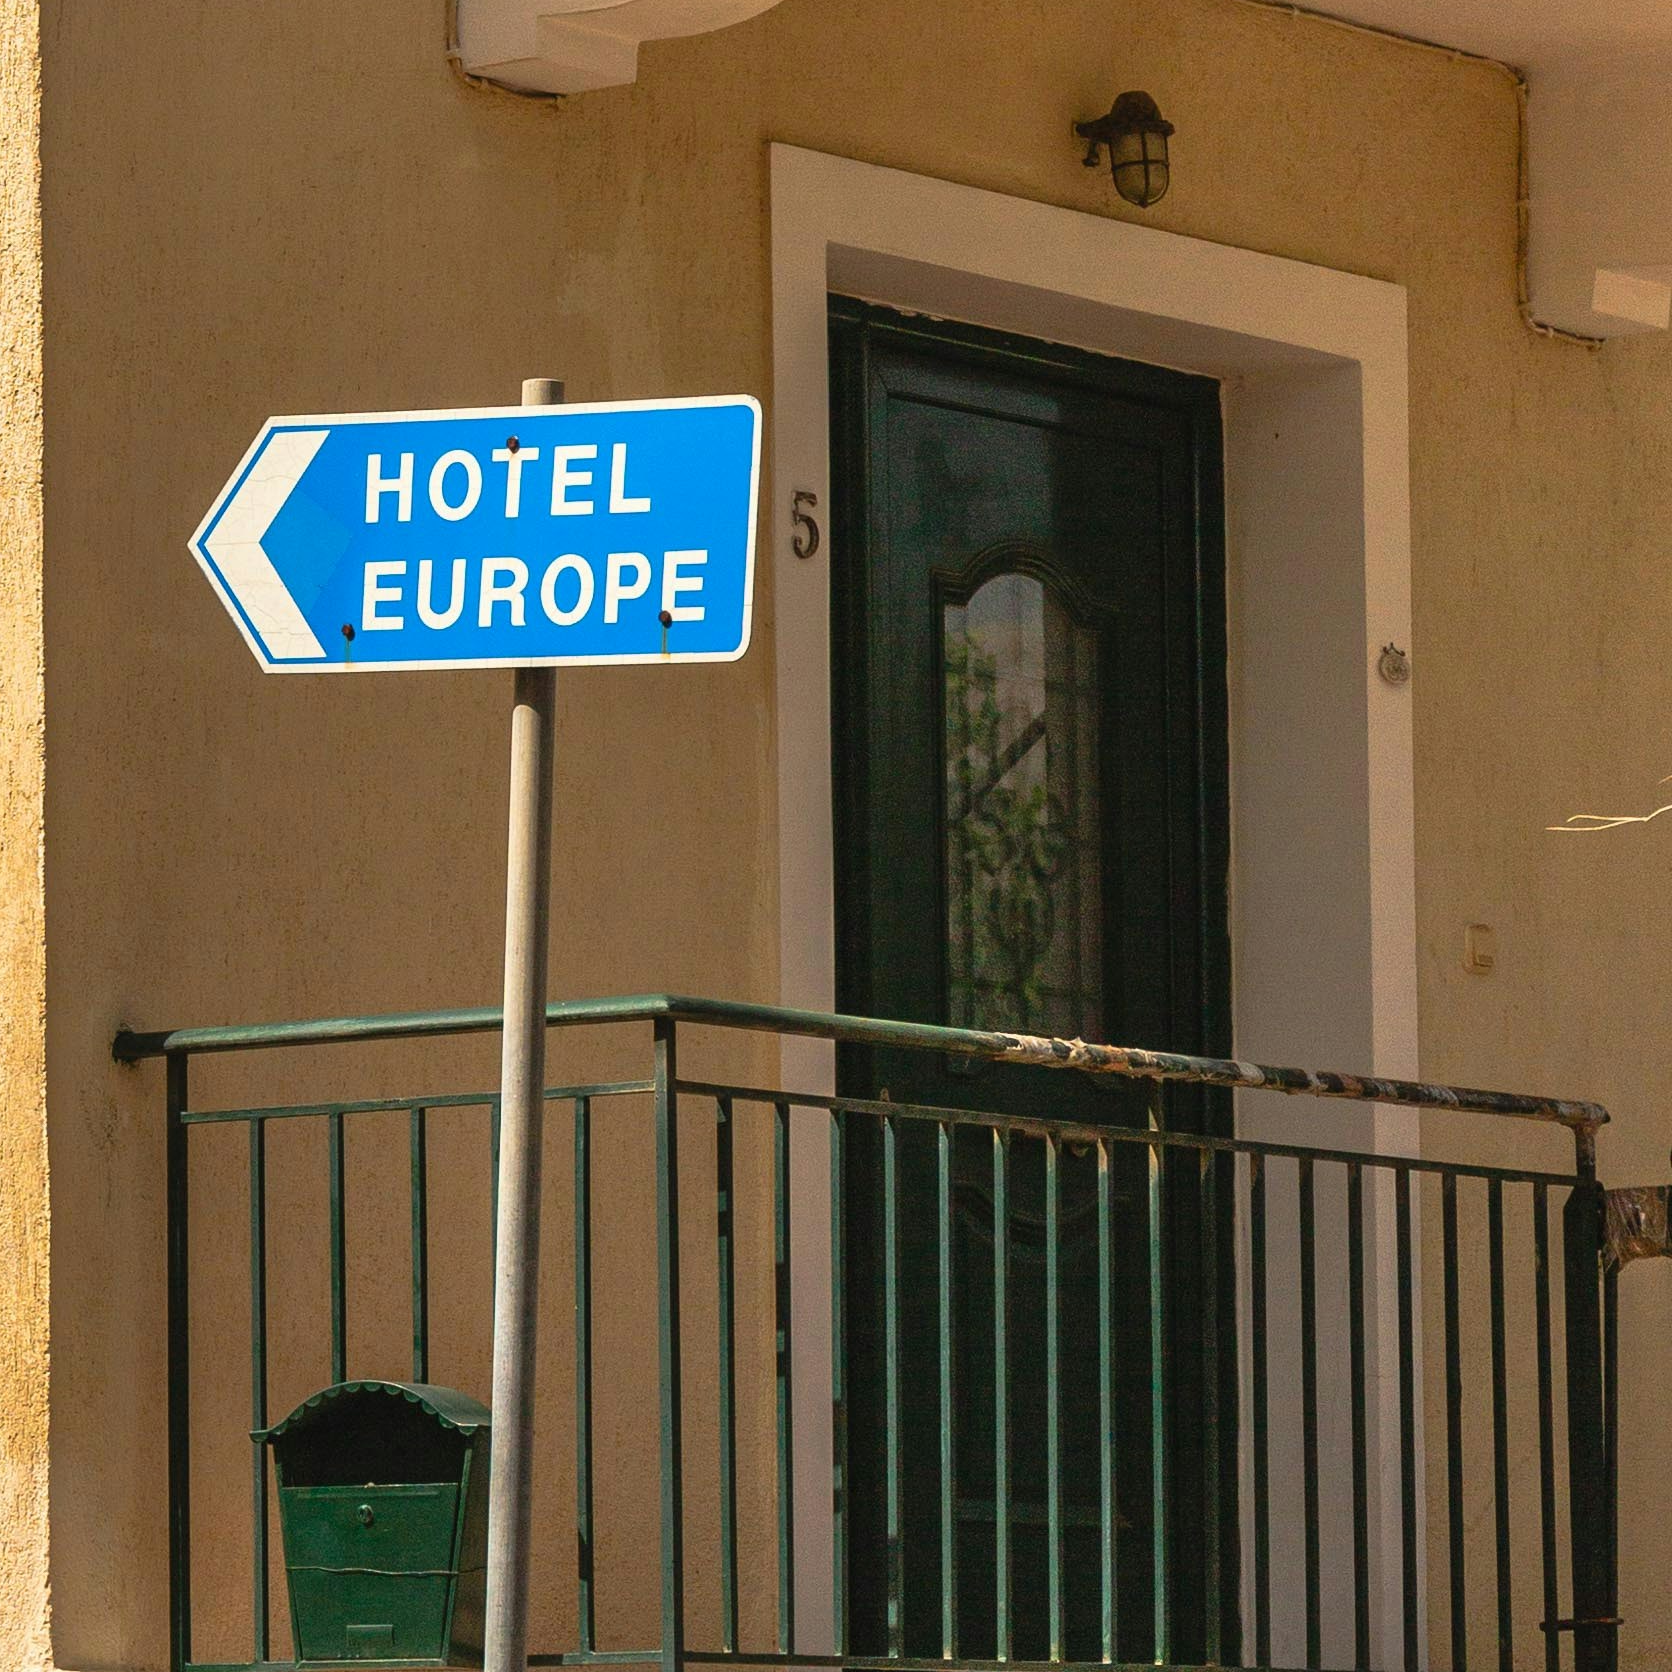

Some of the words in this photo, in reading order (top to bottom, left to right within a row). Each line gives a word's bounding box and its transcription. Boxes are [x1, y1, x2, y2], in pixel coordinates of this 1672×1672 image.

[365, 442, 651, 524] HOTEL
[792, 490, 820, 559] 5
[361, 549, 708, 631] EUROPE
